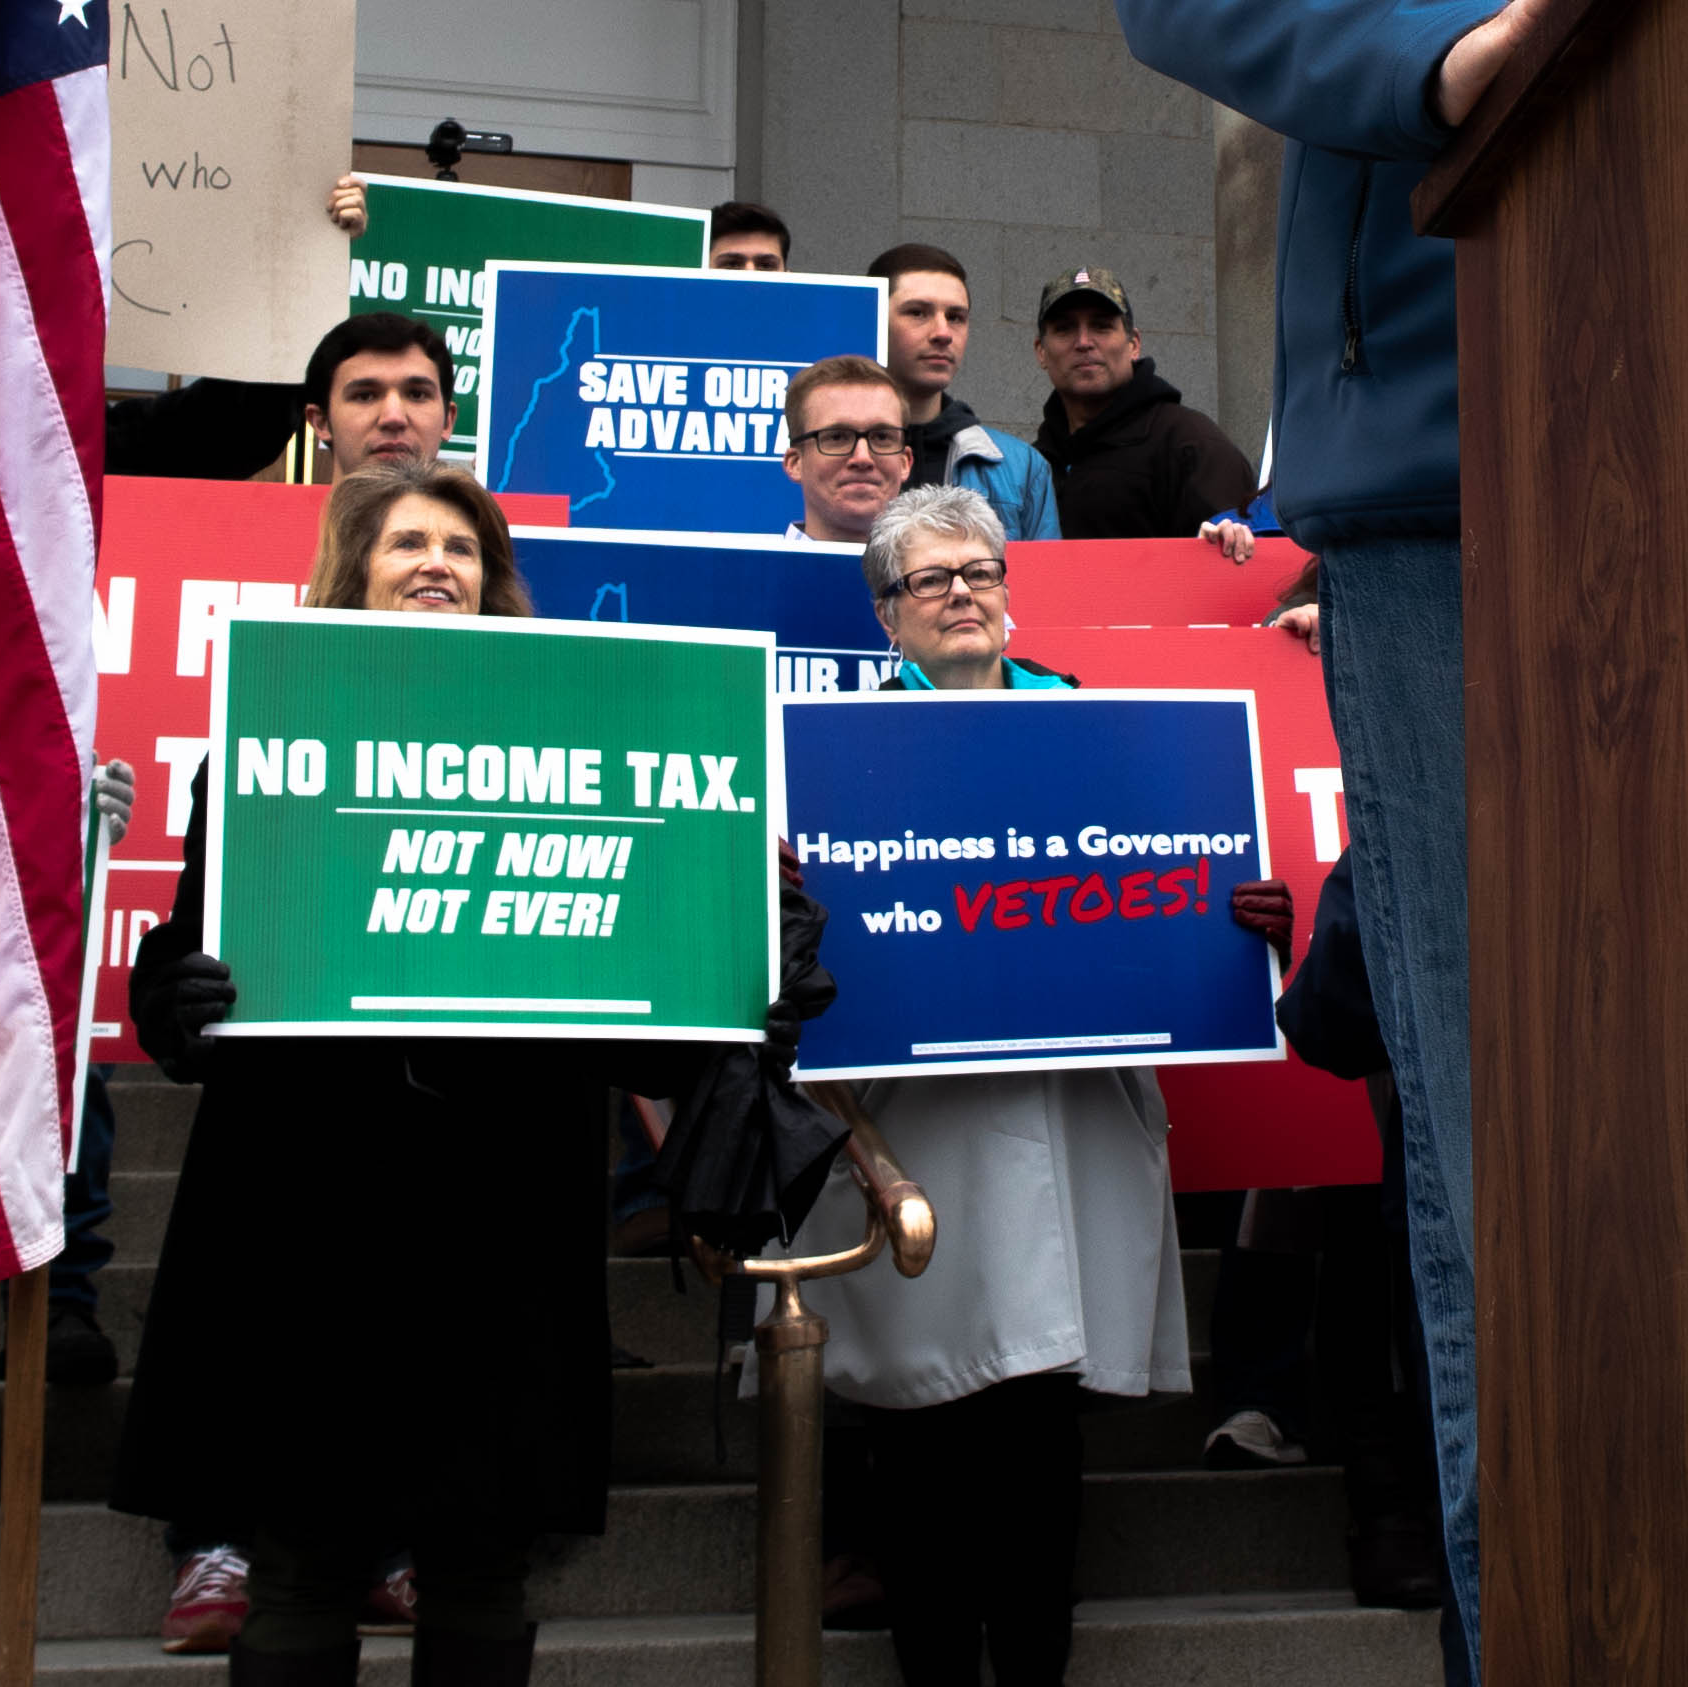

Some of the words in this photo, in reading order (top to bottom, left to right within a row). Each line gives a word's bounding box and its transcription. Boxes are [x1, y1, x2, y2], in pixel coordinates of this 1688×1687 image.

[122, 2, 239, 92] Not
[141, 151, 232, 190] who
[350, 258, 409, 301] NO
[578, 361, 688, 407] SAVE
[703, 366, 787, 411] OUR
[236, 736, 328, 798] NO
[354, 739, 603, 806] INCOME
[626, 750, 757, 813] TAX.
[381, 828, 484, 876] NOT
[494, 831, 634, 879] NOW!
[797, 828, 996, 874] Happiness
[1007, 828, 1036, 861] is
[1045, 834, 1069, 858] a
[1077, 823, 1252, 858] Governor
[366, 886, 469, 934] NOT
[481, 890, 621, 938] EVER!
[861, 900, 943, 935] who
[953, 856, 1211, 935] VETOES!
